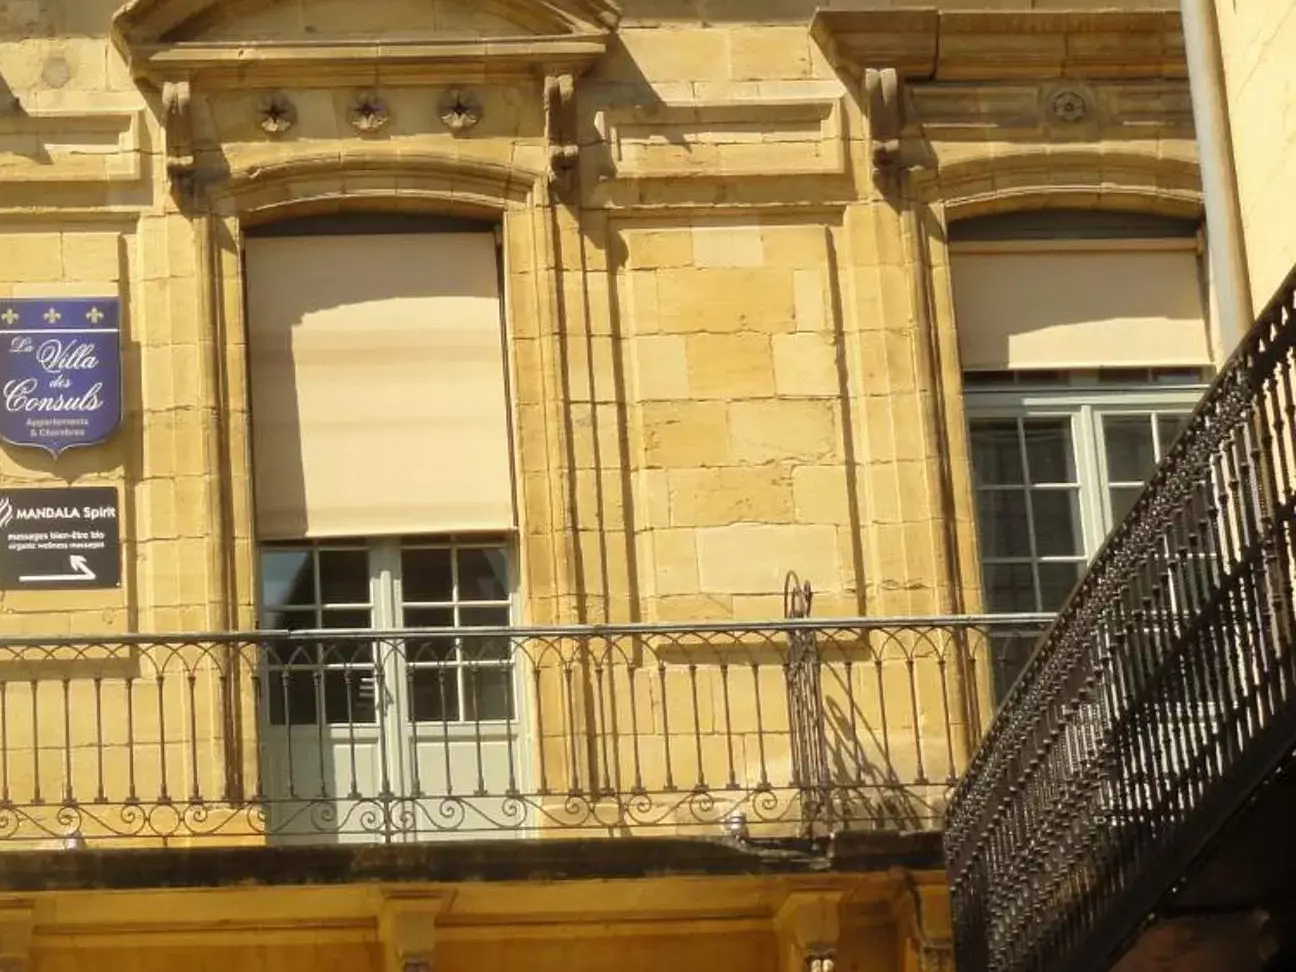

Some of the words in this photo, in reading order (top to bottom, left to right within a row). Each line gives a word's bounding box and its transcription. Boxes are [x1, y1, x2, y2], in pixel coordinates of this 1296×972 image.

[9, 335, 35, 353] La
[35, 339, 99, 373] Villa
[49, 374, 72, 388] des
[3, 378, 104, 412] Consuls
[16, 507, 81, 519] MANDALA
[83, 506, 117, 520] Spirit
